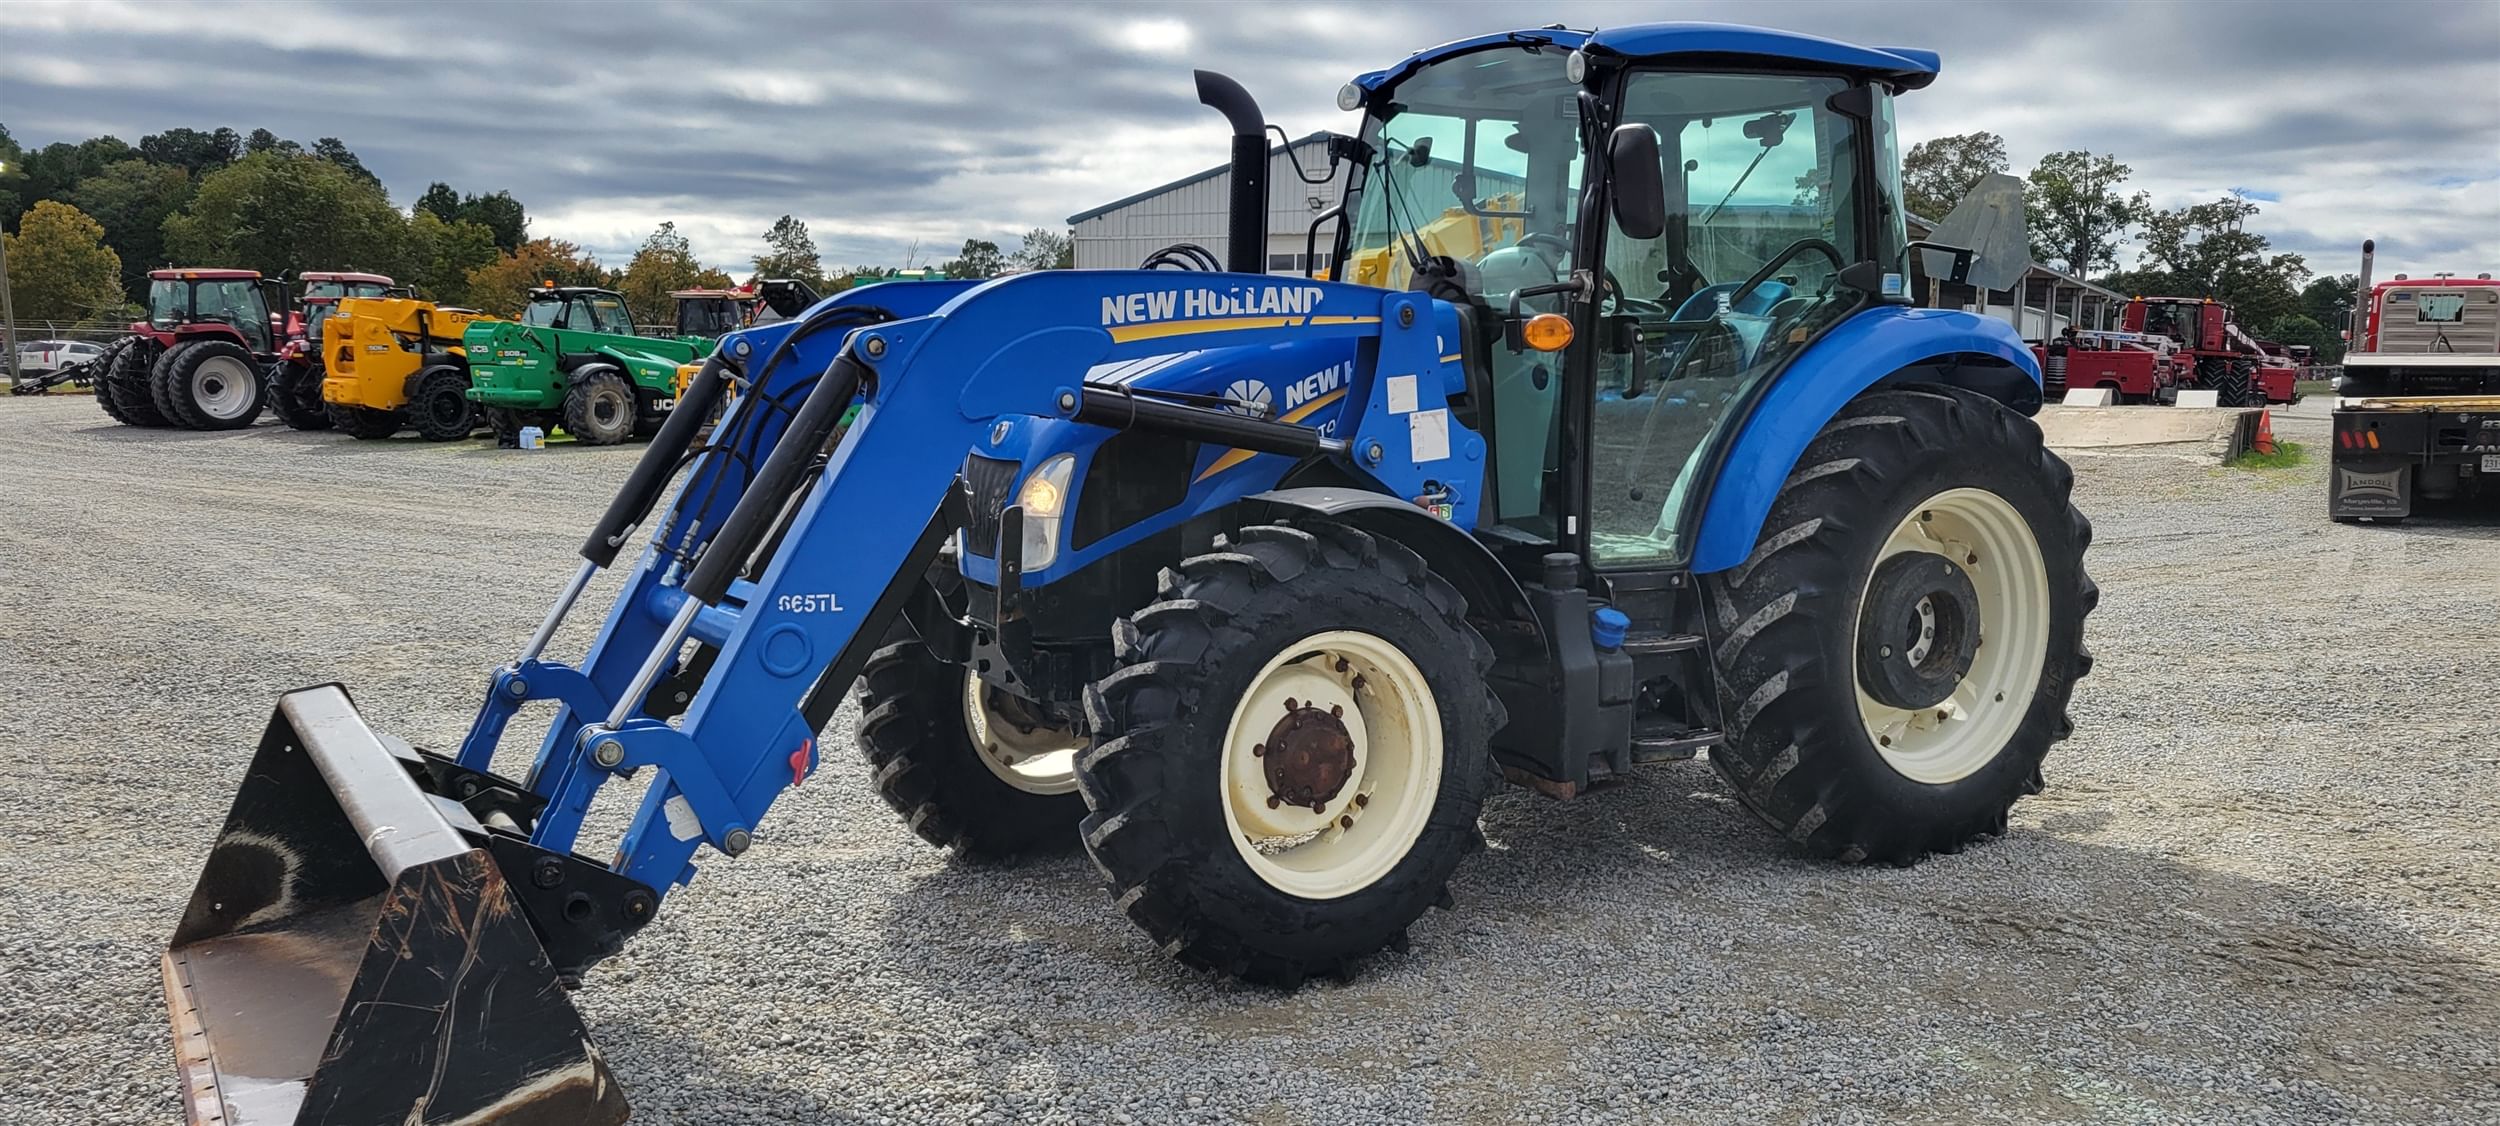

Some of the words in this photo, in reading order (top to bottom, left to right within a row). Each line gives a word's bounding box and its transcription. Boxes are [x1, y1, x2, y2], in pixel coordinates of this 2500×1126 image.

[1102, 290, 1177, 326] NEW
[1184, 284, 1325, 318] HOLLAND
[470, 345, 489, 353] JCB
[1286, 364, 1340, 410] NEW
